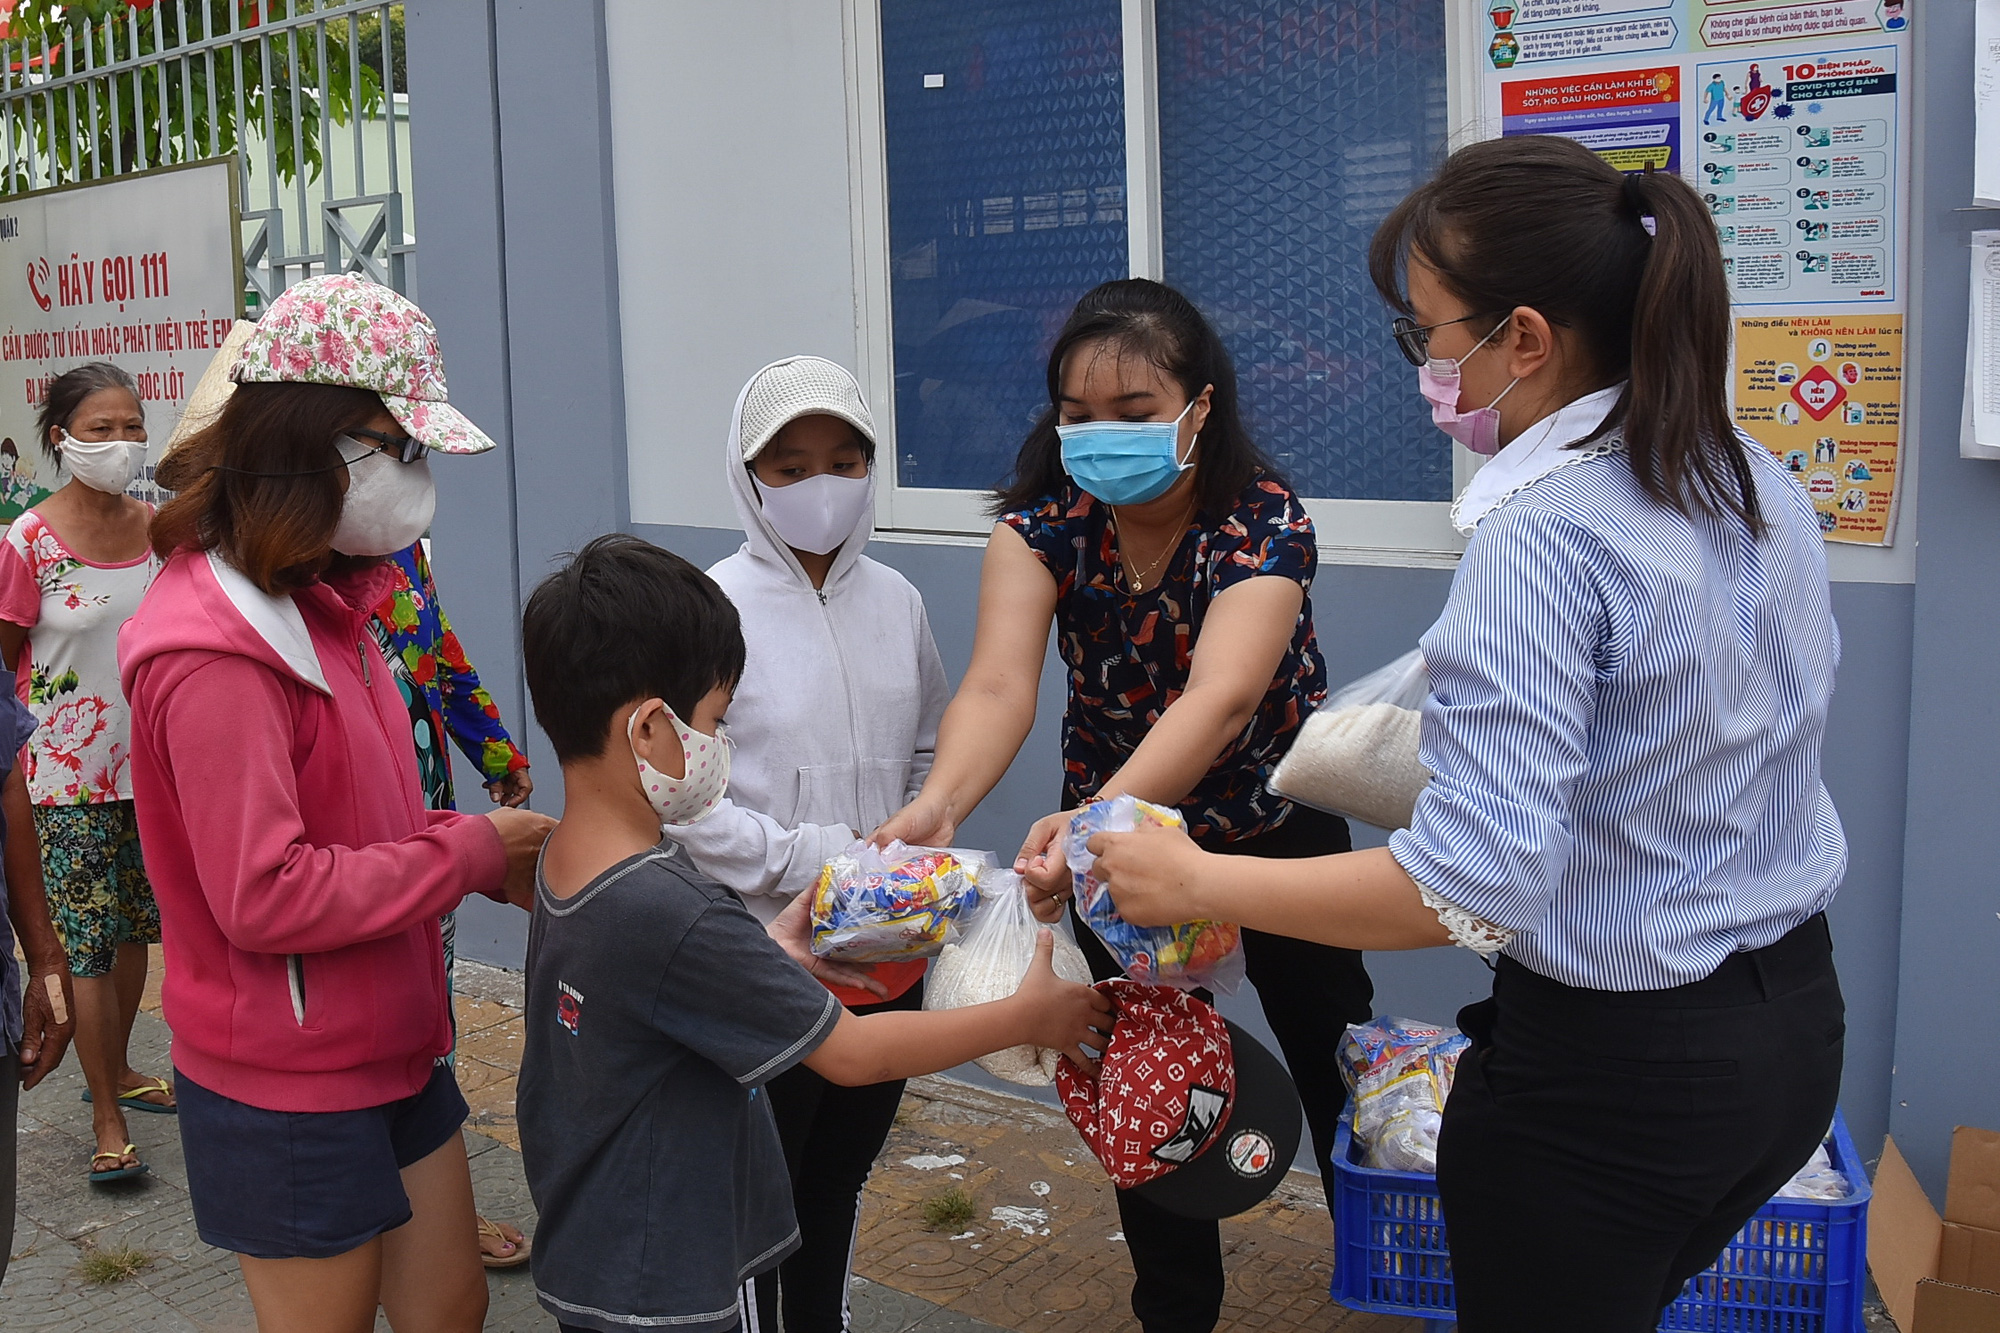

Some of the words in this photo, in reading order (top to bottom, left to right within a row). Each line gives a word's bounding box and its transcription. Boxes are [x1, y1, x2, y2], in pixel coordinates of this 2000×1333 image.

[1782, 63, 1815, 80] 10
[1817, 62, 1840, 70] BIỆN
[1817, 70, 1853, 78] PHÒNG
[1856, 66, 1885, 75] NGỪA
[1525, 87, 1558, 96] NHỮNG
[1560, 84, 1581, 94] VIỆC
[1583, 82, 1602, 91] CẦN
[1605, 80, 1625, 90] LÀM
[1646, 78, 1656, 87] BỊ
[1791, 82, 1836, 91] COVID-19
[1856, 77, 1878, 85] BẢN
[1832, 87, 1862, 96] NHÂN
[1523, 97, 1541, 107] SỐT,
[1562, 95, 1582, 103] ĐAU
[1584, 93, 1614, 103] HỌNG,
[1616, 89, 1636, 98] KHÓ
[1639, 87, 1659, 96] THỞ
[15, 216, 18, 237] 2
[58, 252, 95, 307] HÃY
[102, 255, 135, 312] GỌI
[140, 251, 169, 298] 111
[1791, 318, 1809, 326] NÊN
[2, 325, 22, 362] CẦN
[24, 329, 50, 365] ĐƯỢC
[52, 327, 66, 358] TƯ
[67, 321, 89, 357] VẤN
[92, 322, 120, 361] HOẶC
[123, 318, 151, 354] PHÁT
[154, 317, 183, 358] HIỆN
[185, 309, 209, 350] TRẺ
[213, 318, 232, 348] EM
[26, 378, 36, 410] BỊ
[138, 366, 160, 401] BÓC
[163, 366, 185, 407] LỘT
